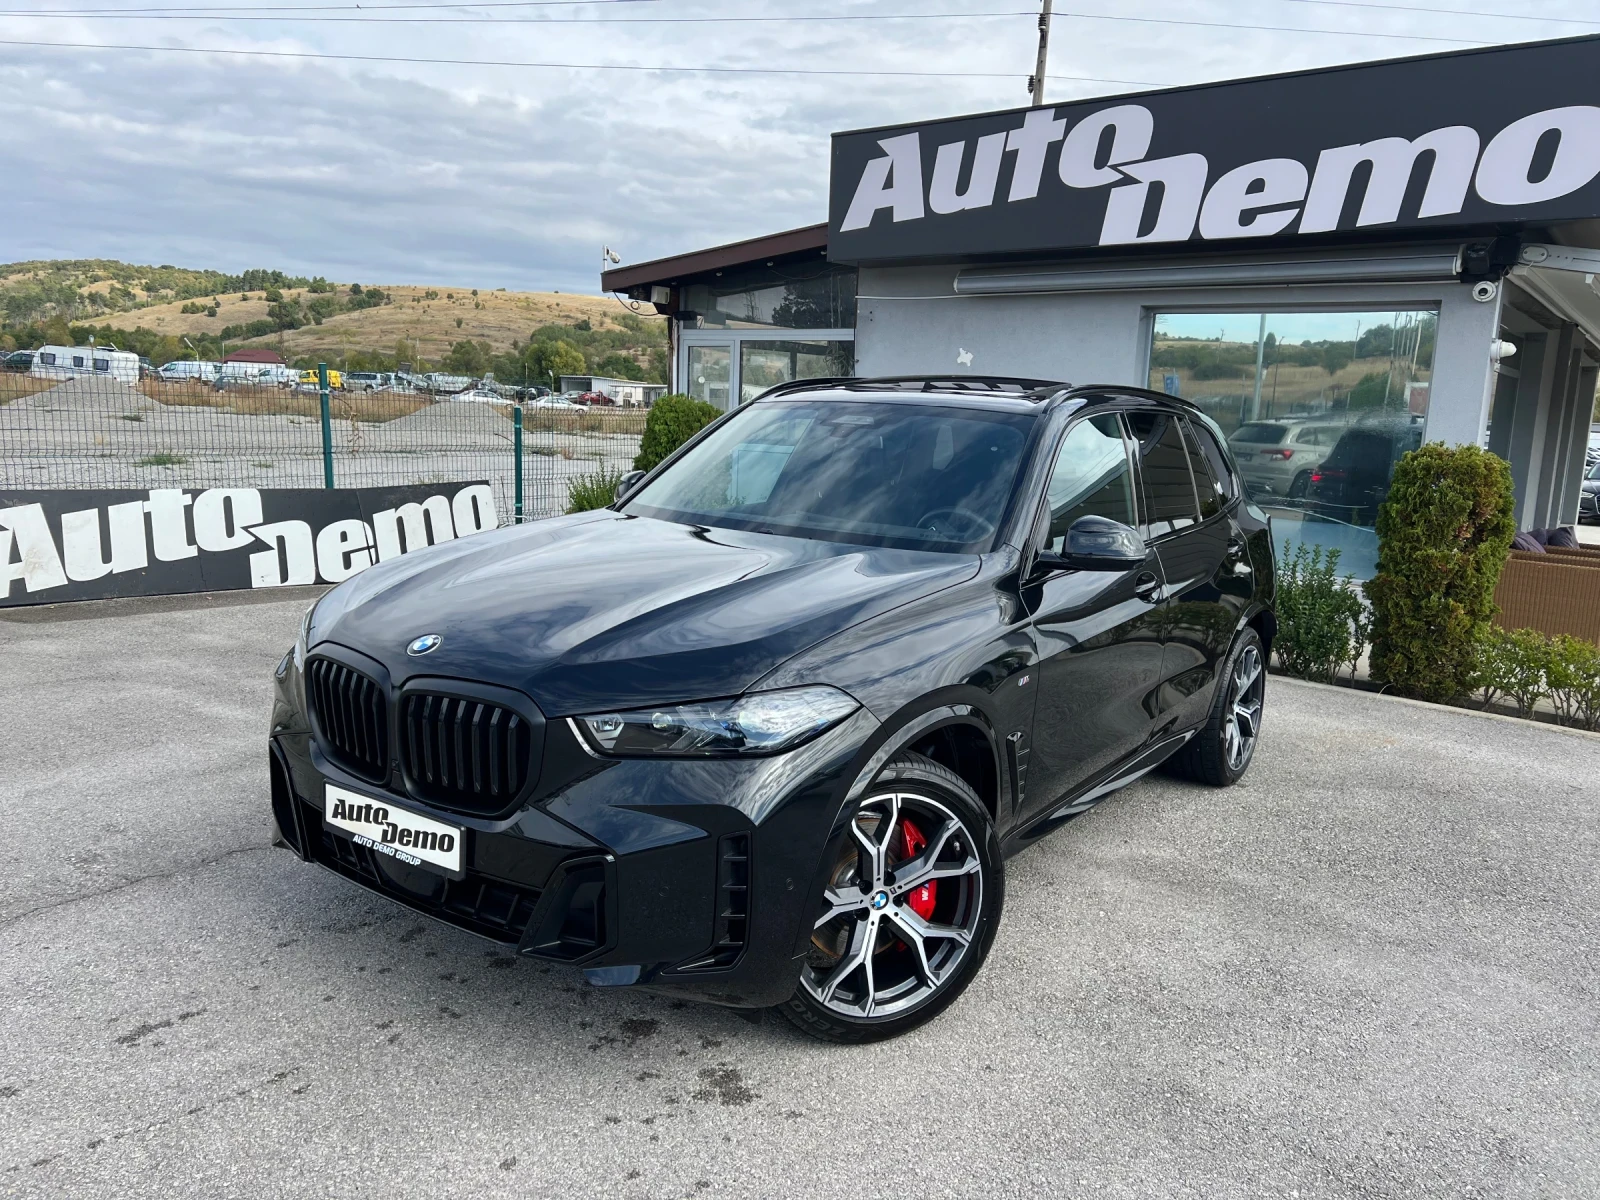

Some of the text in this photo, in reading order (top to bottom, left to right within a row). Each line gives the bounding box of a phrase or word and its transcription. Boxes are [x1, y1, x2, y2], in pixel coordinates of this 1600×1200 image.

[840, 104, 1154, 232] Auto
[1099, 105, 1600, 246] Demo
[0, 488, 263, 598] Auto
[249, 485, 498, 588] Demo
[331, 798, 389, 825] Auto
[352, 834, 421, 866] AUTO DEMO GROUP
[380, 821, 455, 852] Demo
